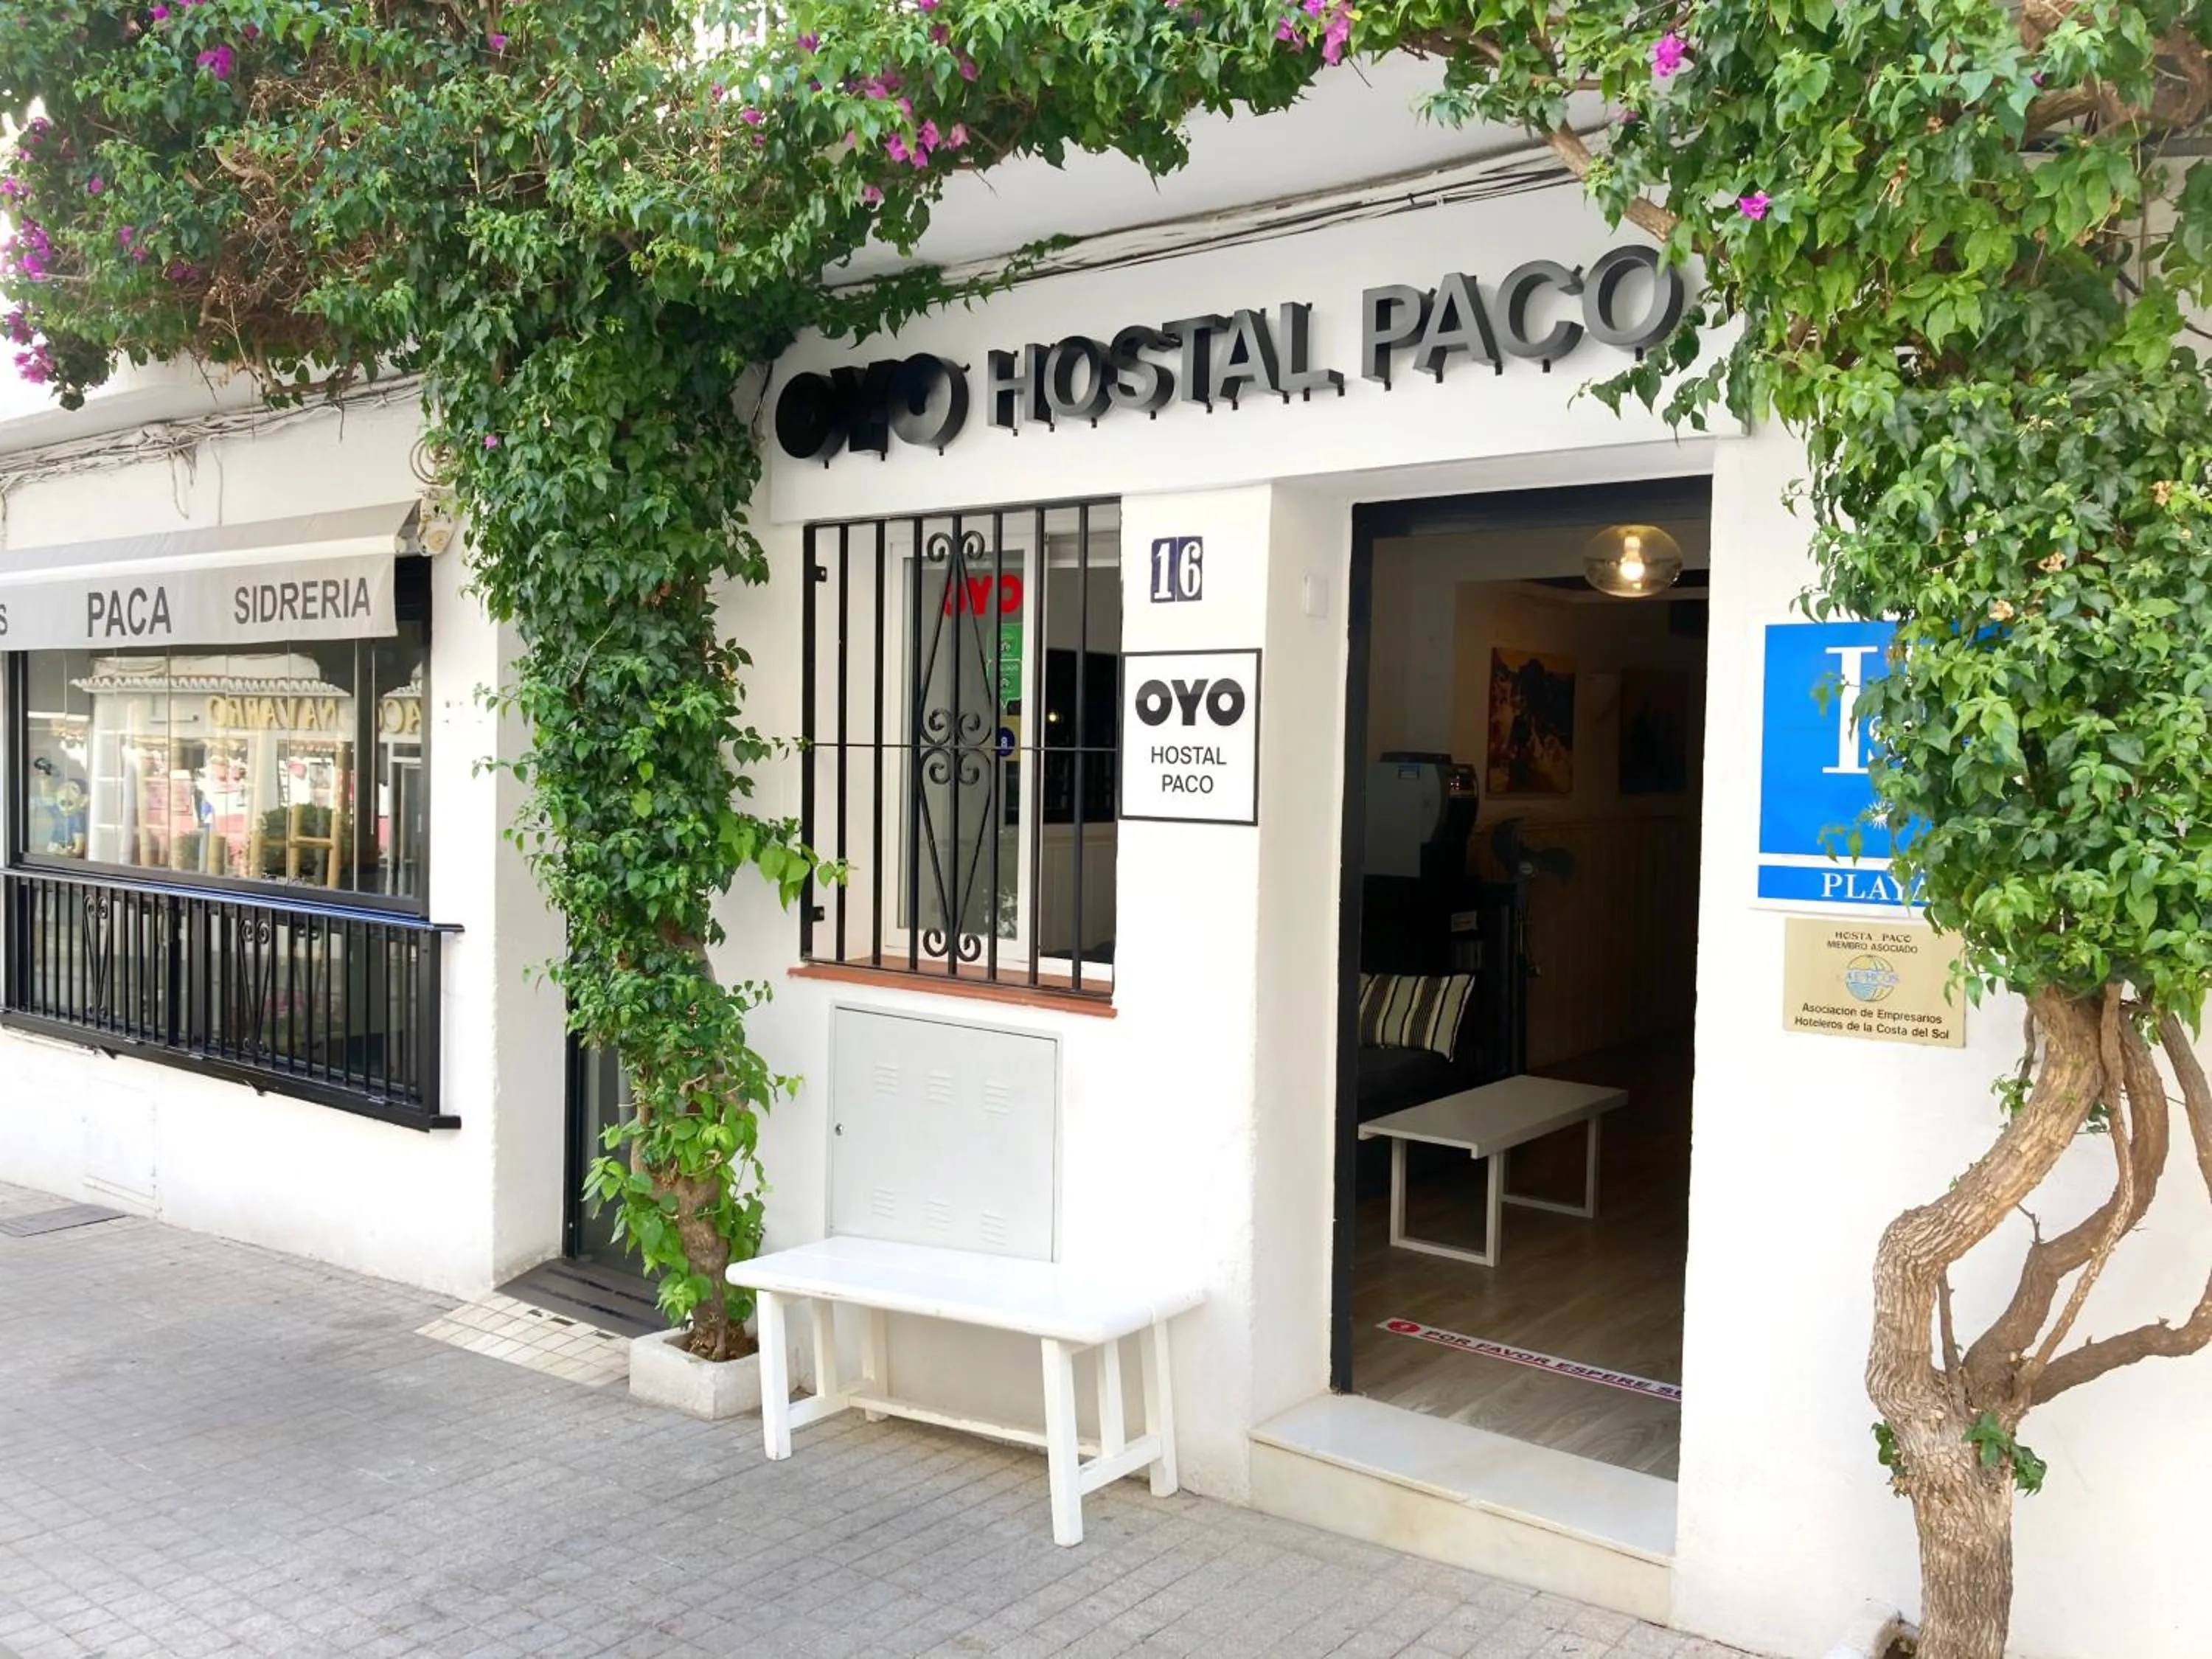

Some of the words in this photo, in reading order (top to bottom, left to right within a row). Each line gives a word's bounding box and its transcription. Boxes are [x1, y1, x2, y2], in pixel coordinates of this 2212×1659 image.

[987, 302, 1344, 429] HOSTAL
[1362, 245, 1683, 383] PACO
[1153, 540, 1201, 599] 16
[87, 587, 172, 637] PACA
[234, 577, 371, 625] SIDRERIA
[1135, 678, 1245, 726] OYO
[1150, 746, 1227, 765] HOSTAL
[1161, 774, 1214, 793] PACO
[1826, 940, 1868, 950] MIEMBRO
[1871, 943, 1918, 953] ASOCIADO
[1882, 933, 1912, 942] PACO
[1794, 1016, 1843, 1030] Hoteleros
[1847, 1021, 1860, 1031] de
[1863, 1022, 1873, 1032] la
[1877, 1023, 1907, 1035] Costa
[1912, 1028, 1928, 1037] del
[1931, 1029, 1950, 1039] Sol
[1860, 1009, 1874, 1018] de
[1877, 1009, 1942, 1024] Empresarios
[1421, 1330, 1471, 1346] POR
[1475, 1343, 1551, 1364] FAVOR
[1555, 1362, 1652, 1389] ESPERE
